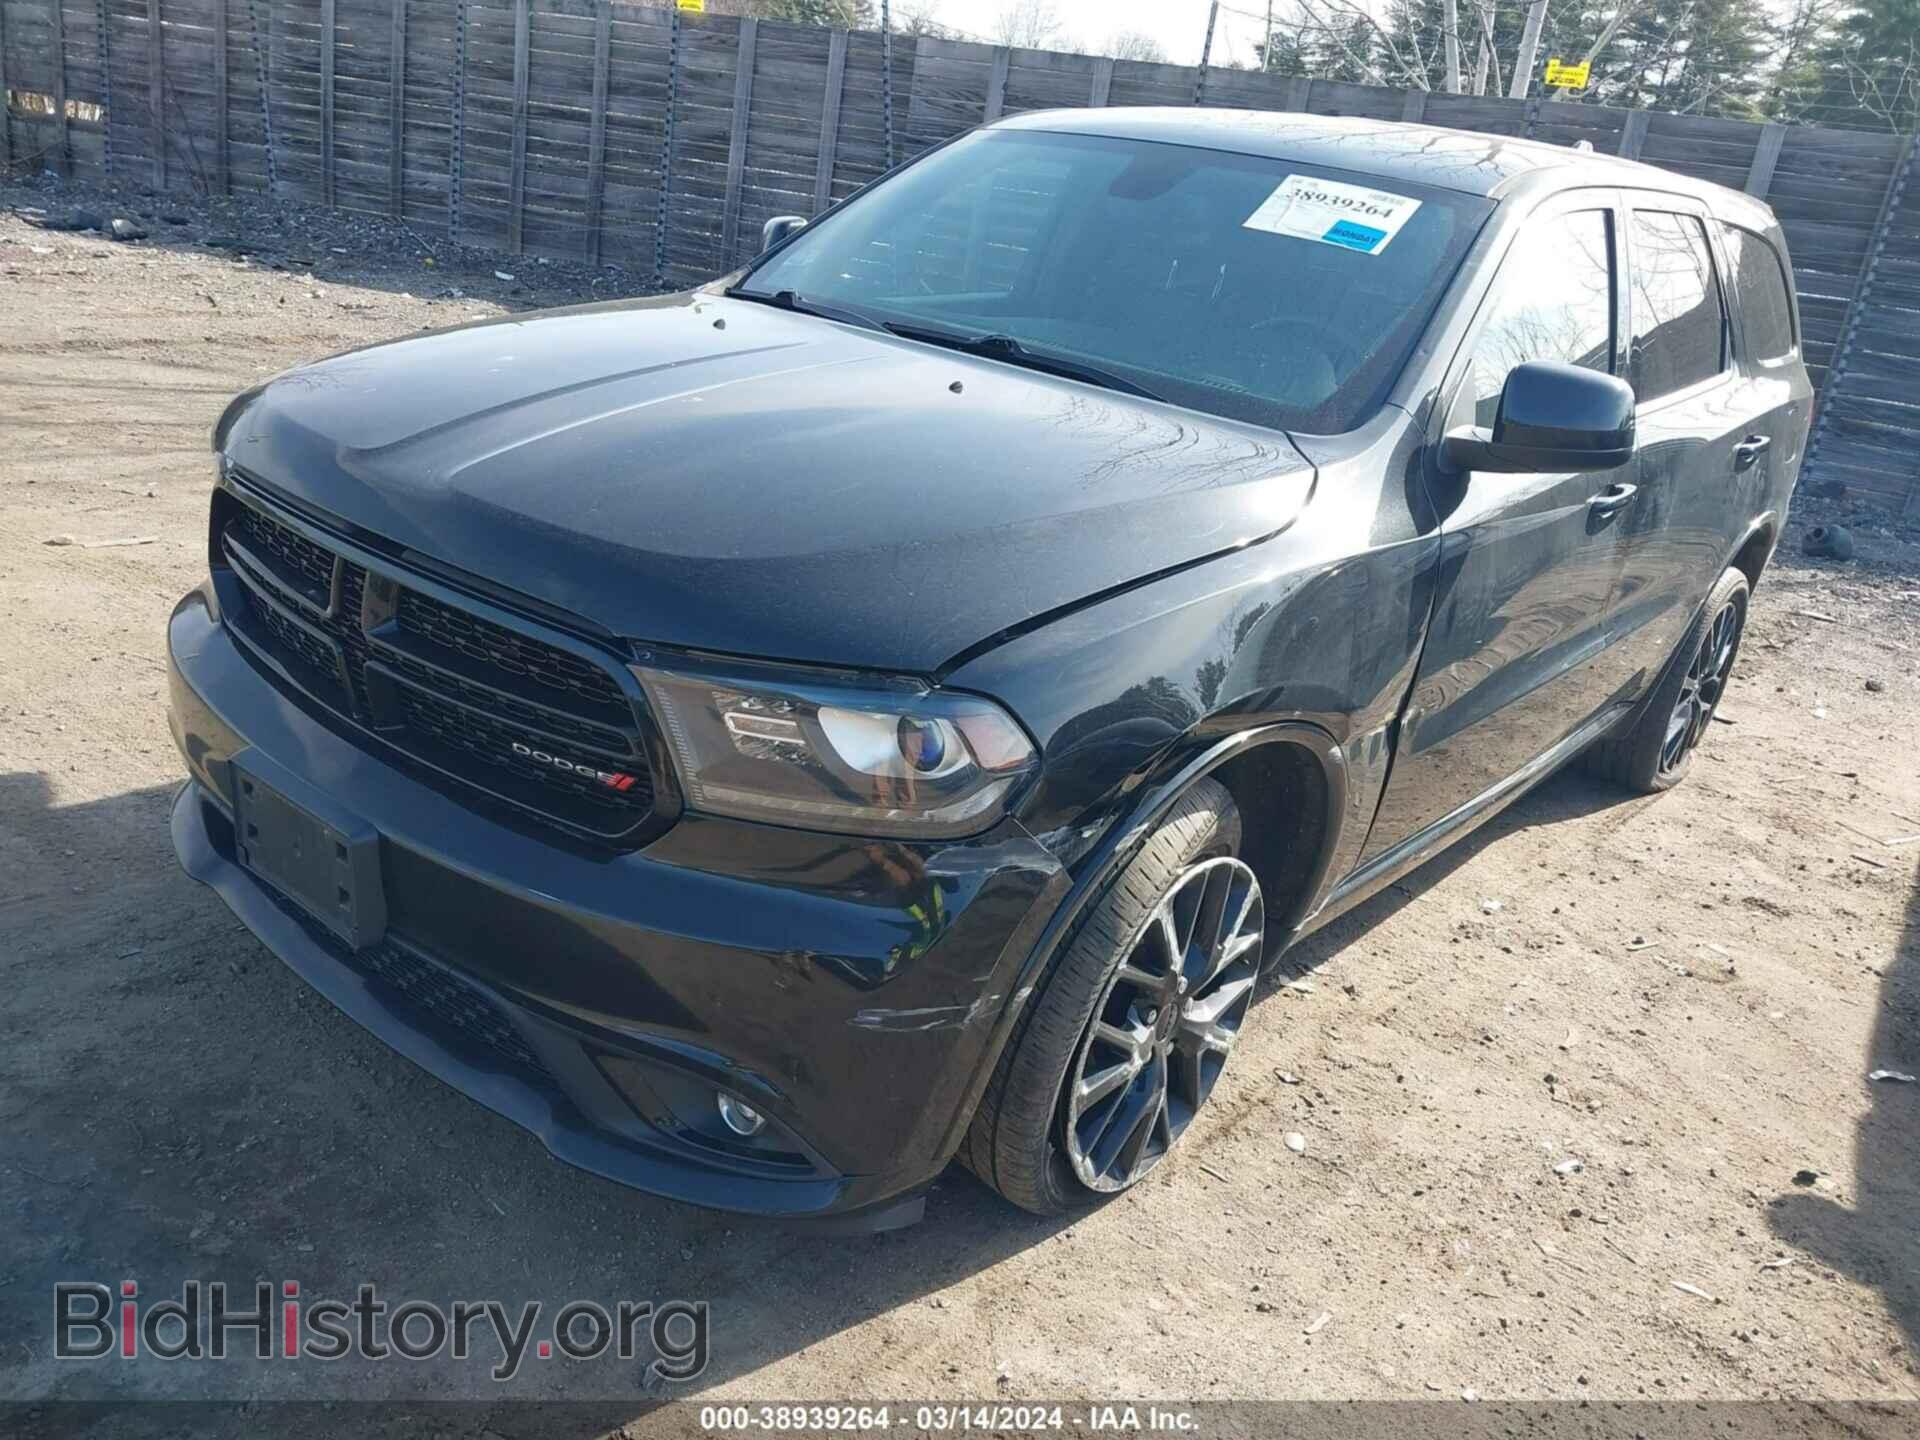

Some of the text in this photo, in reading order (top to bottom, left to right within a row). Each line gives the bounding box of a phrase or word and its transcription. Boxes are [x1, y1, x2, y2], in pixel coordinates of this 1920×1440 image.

[1287, 188, 1395, 219] 38939264
[1331, 227, 1376, 243] MONDAY
[512, 742, 617, 787] DODGE
